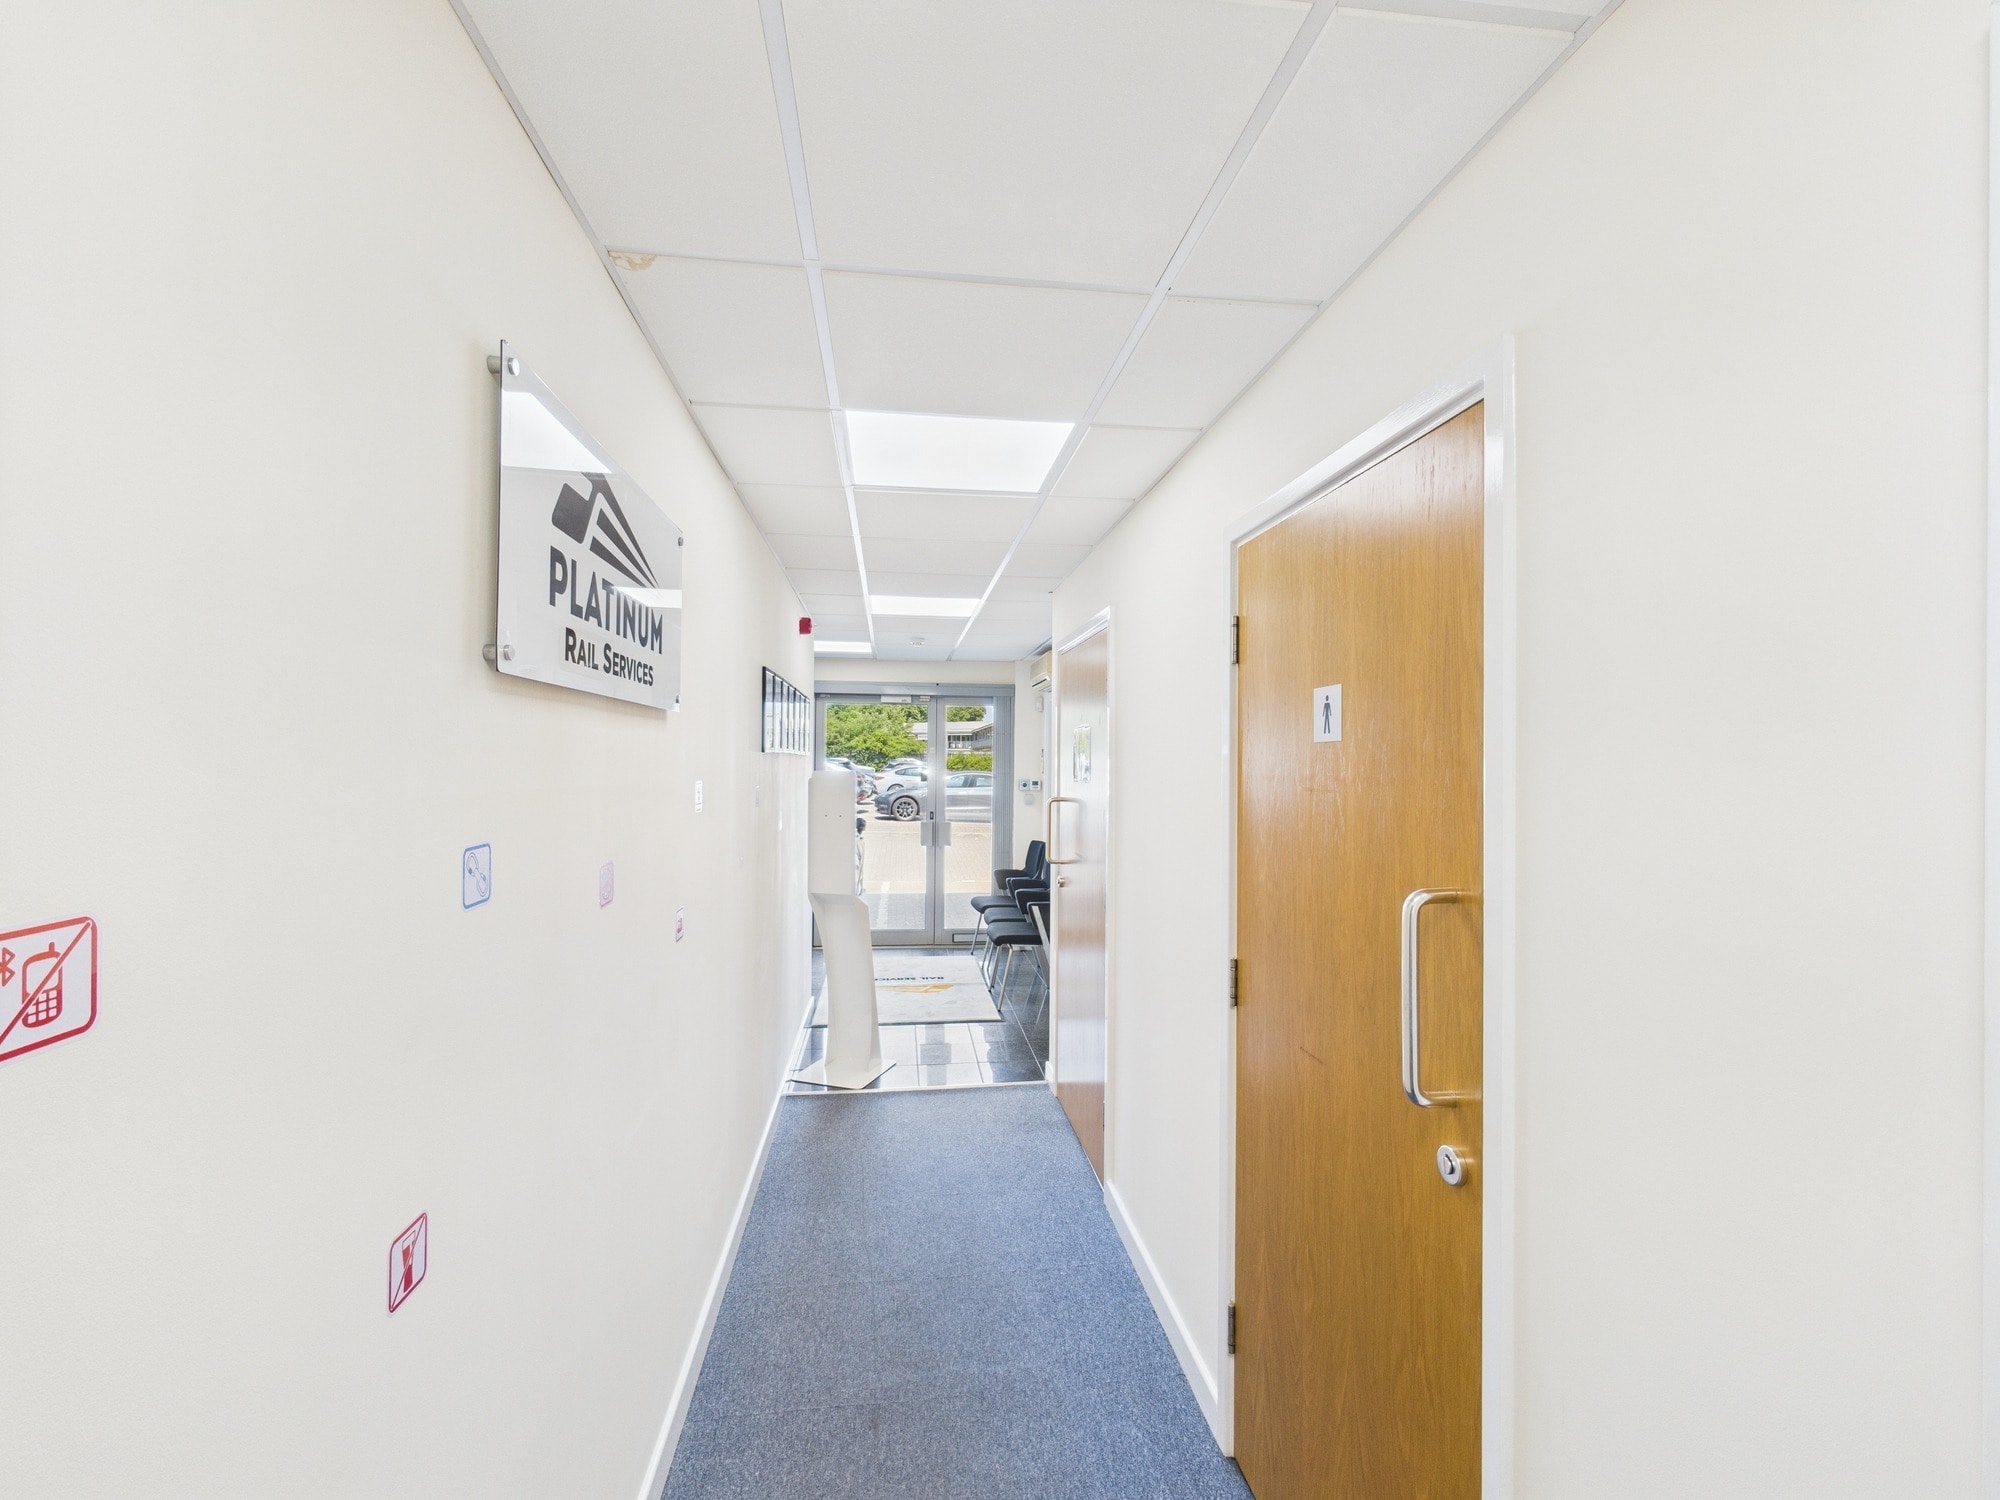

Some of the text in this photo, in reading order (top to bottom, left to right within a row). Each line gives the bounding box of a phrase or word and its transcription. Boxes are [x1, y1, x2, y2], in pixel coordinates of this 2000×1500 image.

[549, 545, 663, 655] PLATINUM
[565, 626, 654, 687] RAIL SERVICES
